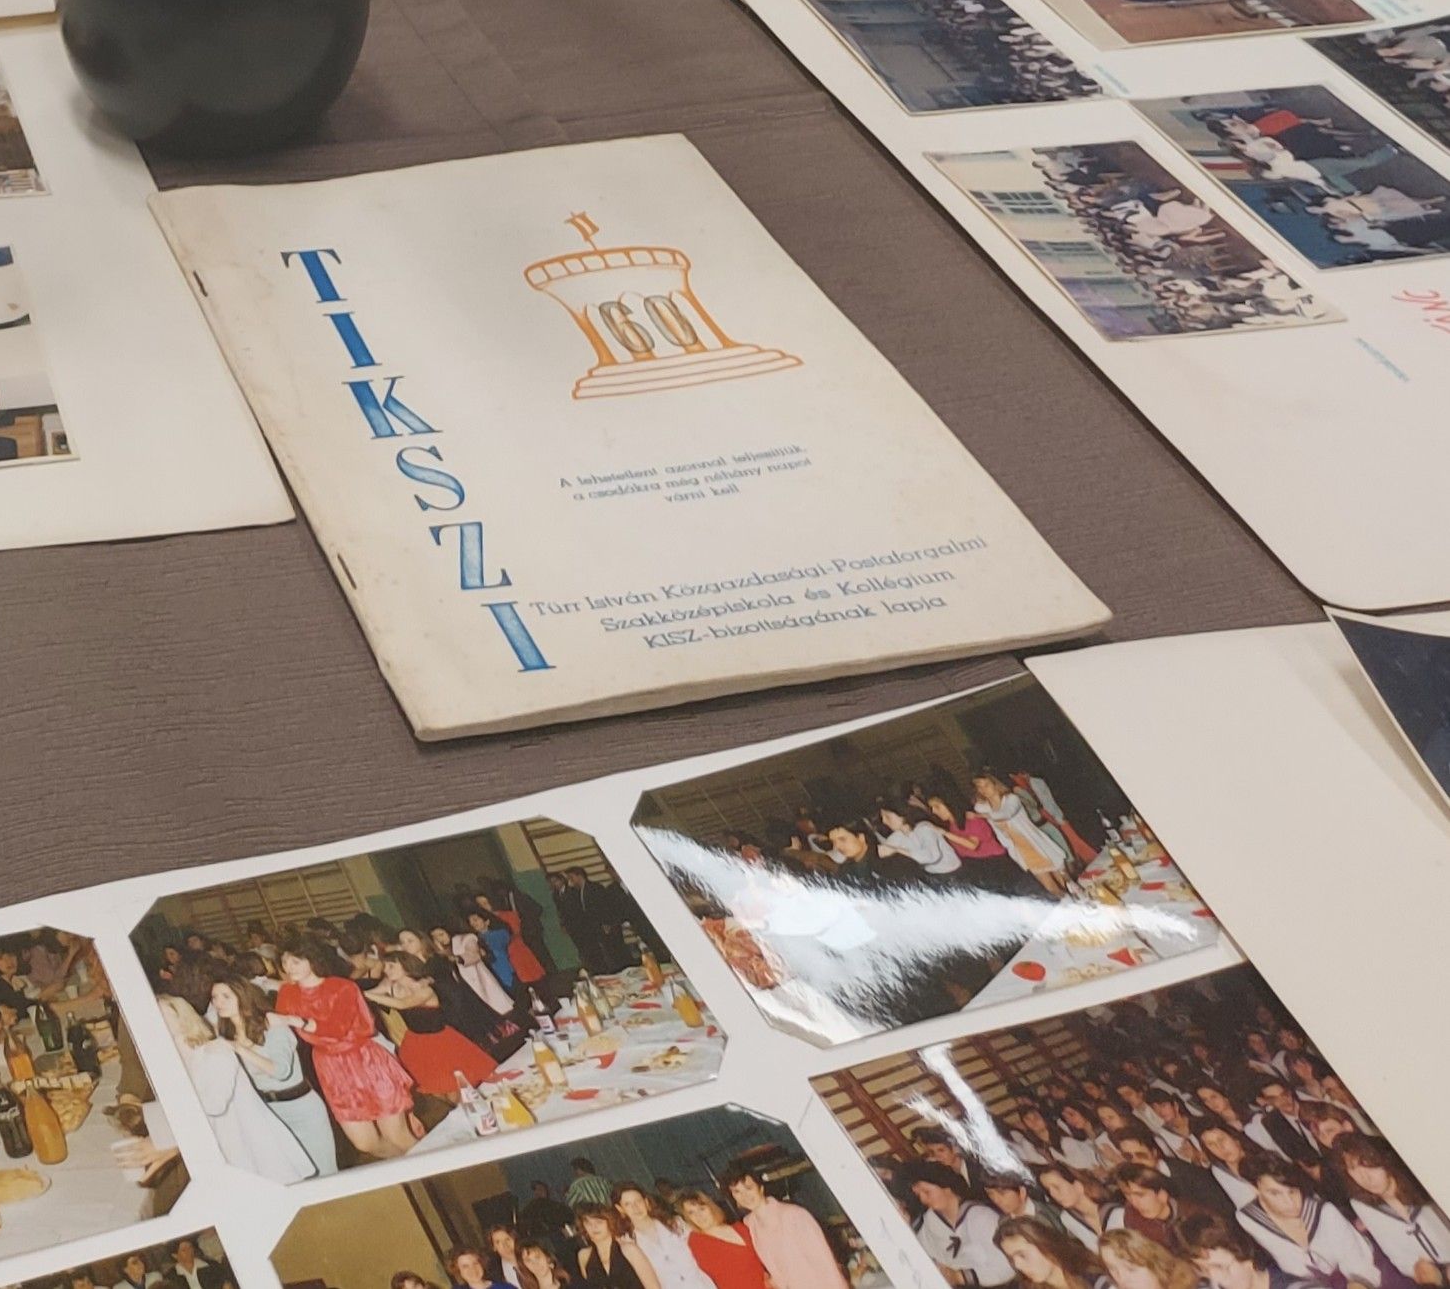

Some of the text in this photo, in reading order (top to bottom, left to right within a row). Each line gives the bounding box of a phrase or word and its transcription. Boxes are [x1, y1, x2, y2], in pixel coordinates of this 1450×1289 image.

[598, 295, 698, 353] 60
[281, 248, 556, 672] TIKSZI
[559, 477, 572, 488] A
[664, 456, 727, 474] azonnal
[573, 457, 812, 501] a csodákra még néhány napot
[664, 483, 740, 503] várni kell
[529, 534, 988, 617] Türr István Közgazdasági-Postaforgalmi
[599, 567, 956, 634] Szakközépiskola és Kollégium
[642, 593, 947, 649] KISZ-bizottságának lapja
